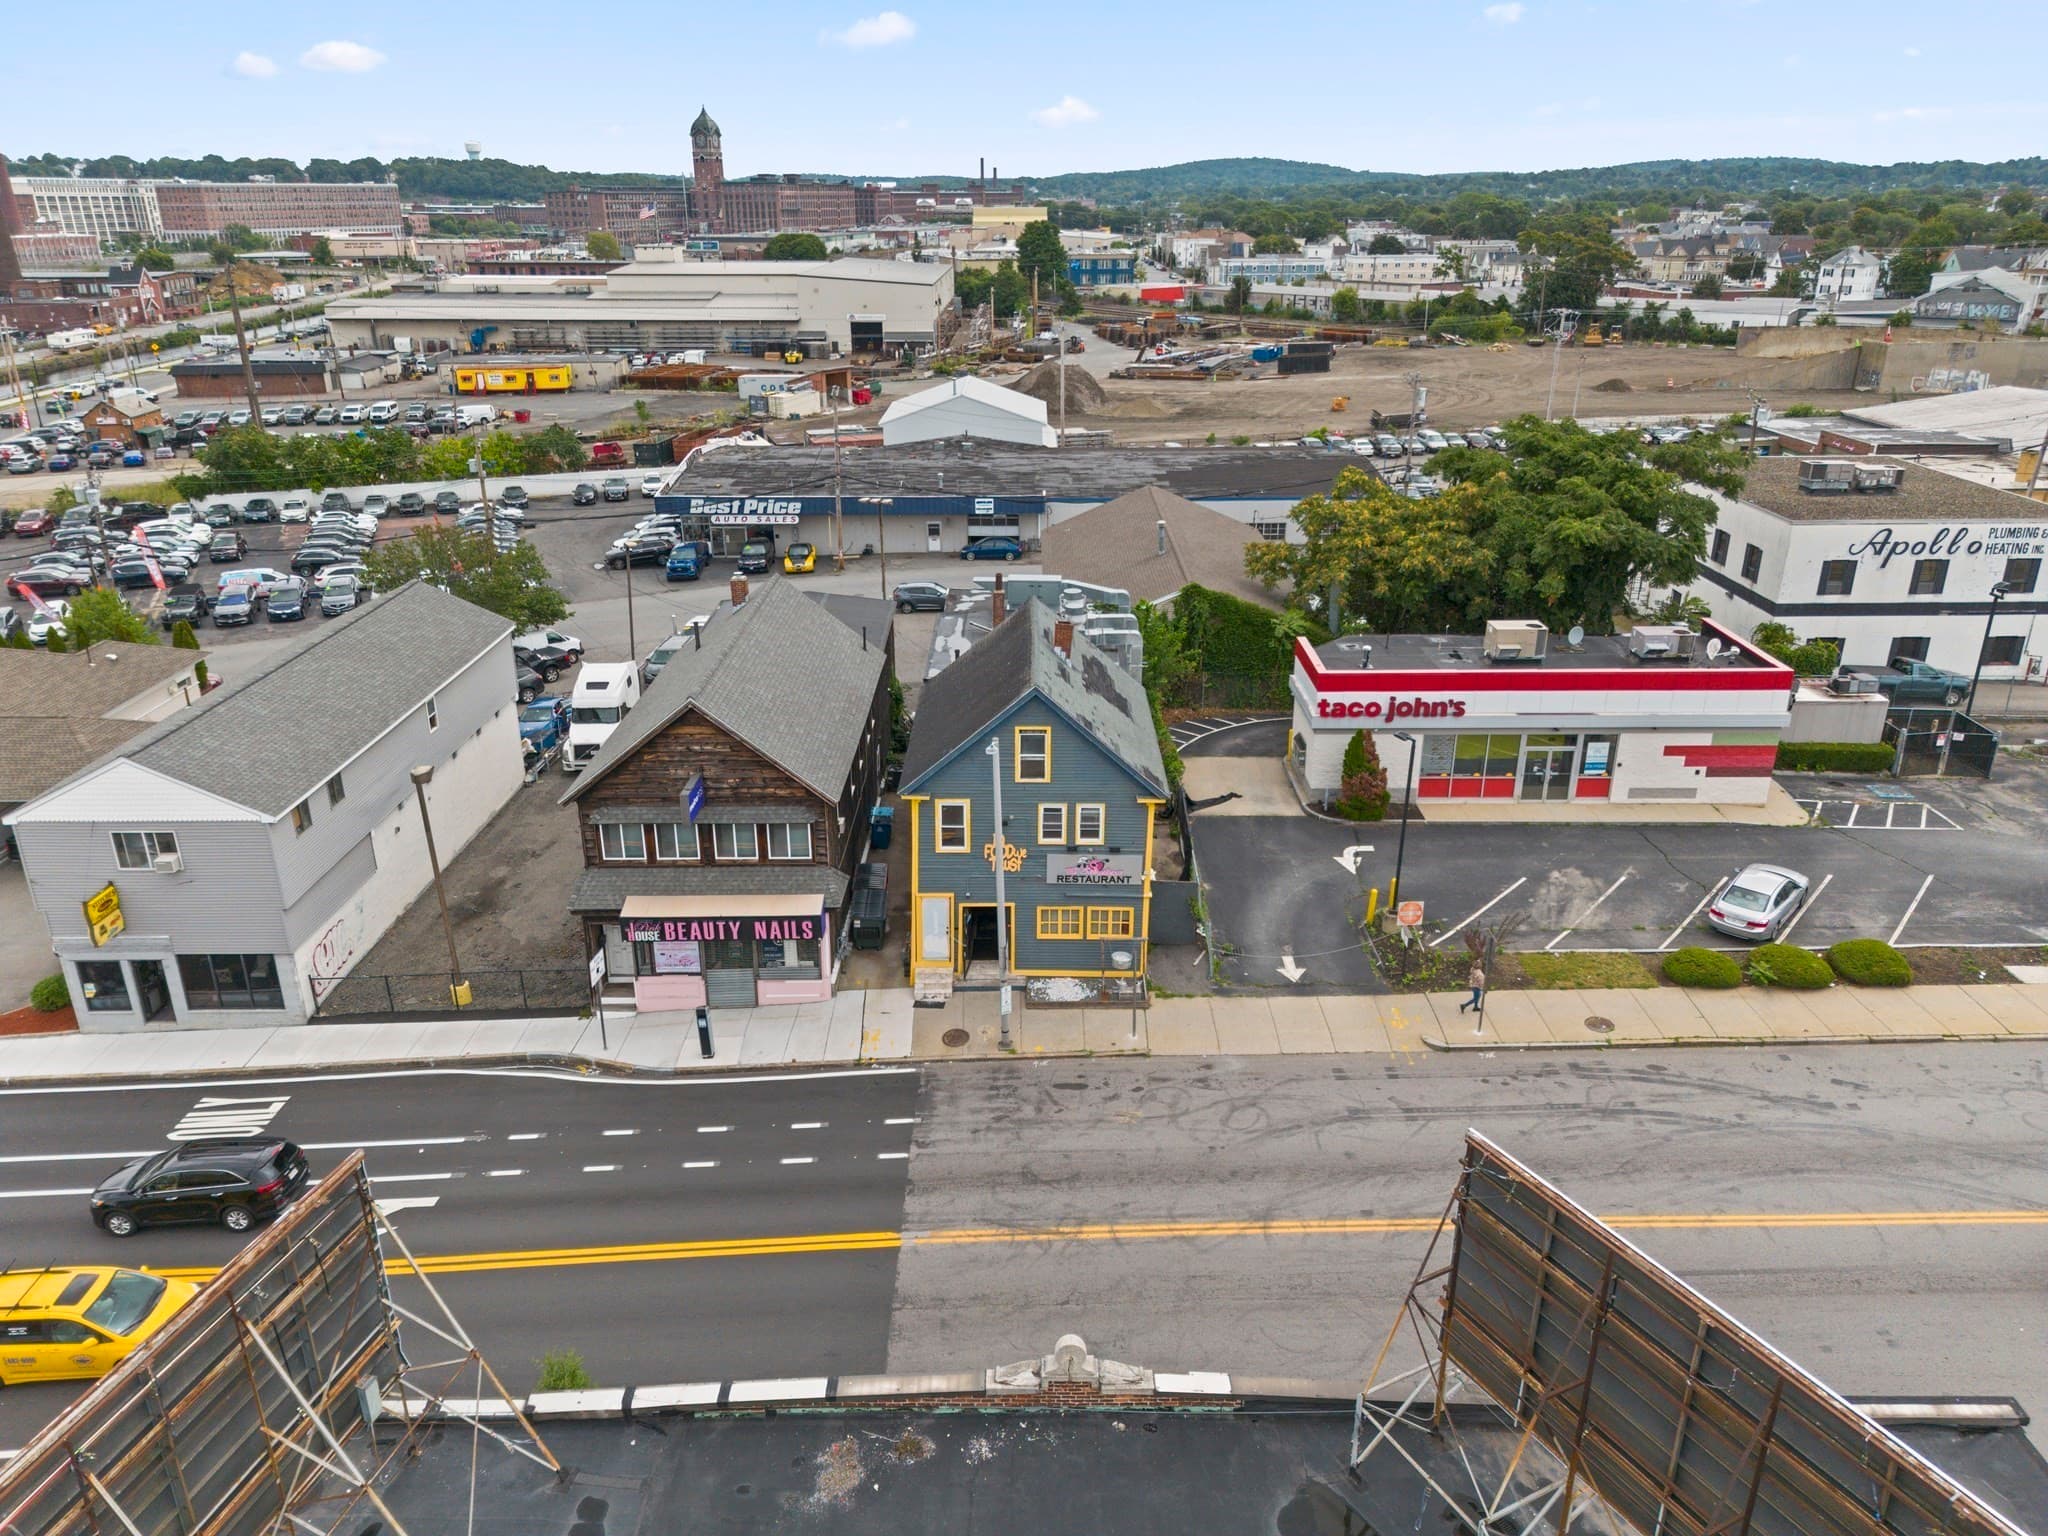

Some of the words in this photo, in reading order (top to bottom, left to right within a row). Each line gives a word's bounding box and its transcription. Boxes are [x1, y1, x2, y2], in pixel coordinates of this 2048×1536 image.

[690, 499, 741, 514] Best
[743, 499, 802, 514] Price
[1988, 527, 2039, 539] PLUMBING
[1848, 527, 1983, 569] Apollo
[1984, 542, 2029, 555] HEATING
[1317, 698, 1382, 718] taco
[1384, 696, 1466, 723] john's
[988, 856, 1022, 872] TUST
[1056, 875, 1132, 884] RESTAURANT
[664, 921, 741, 941] BEAUTY
[754, 921, 814, 940] NAILS
[166, 1096, 291, 1140] ONLY
